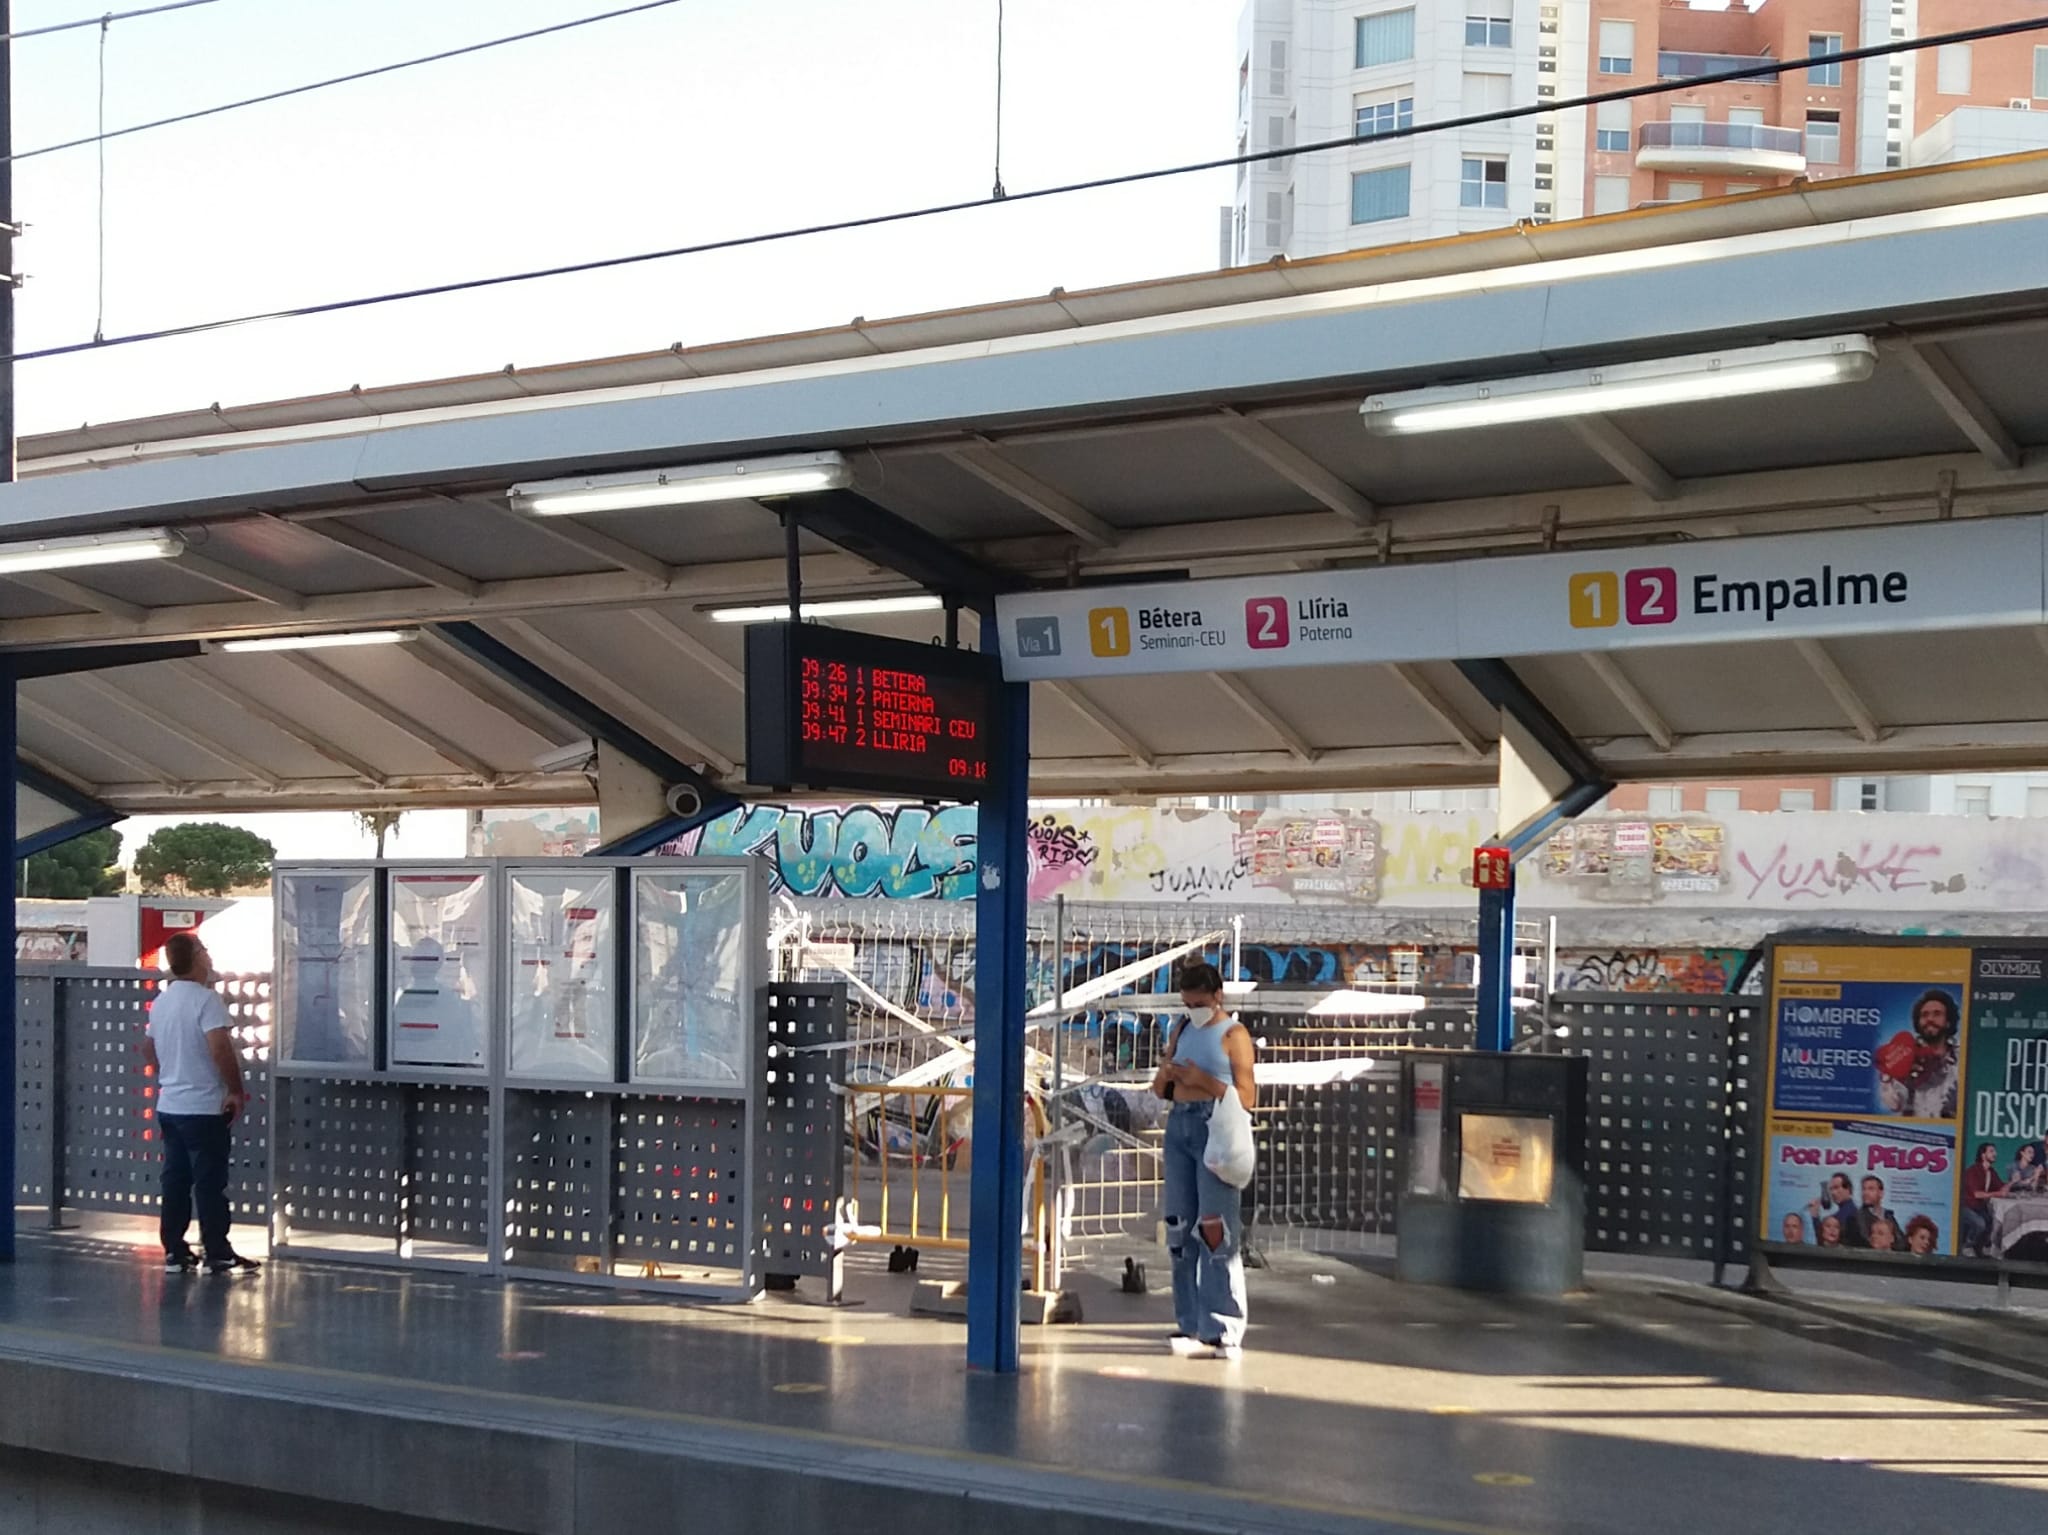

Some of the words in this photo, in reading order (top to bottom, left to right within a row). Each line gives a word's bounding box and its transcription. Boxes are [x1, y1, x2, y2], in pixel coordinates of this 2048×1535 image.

[1583, 581, 1601, 619] 1
[1639, 577, 1665, 616] 2
[1693, 565, 1908, 622] Empalme
[1138, 607, 1203, 630] Bétera
[1298, 597, 1349, 621] Llíria
[1100, 615, 1117, 650] 1
[1255, 604, 1279, 642] 2
[1299, 625, 1353, 642] Paterna
[1043, 626, 1056, 651] 1
[1138, 630, 1227, 650] Seminari-CEU
[857, 666, 864, 685] 1
[872, 669, 927, 693] BETERA
[855, 687, 866, 705] 2
[872, 689, 935, 714] PATERNA
[857, 708, 864, 726] 1
[872, 710, 942, 735] SEMINARI
[949, 719, 976, 740] CEU
[855, 728, 866, 747] 2
[872, 730, 927, 753] LLIRIA
[1979, 962, 2042, 975] OLYMPIA
[1784, 1006, 1881, 1026] HOMBRES
[1781, 1047, 1872, 1067] MUJERES
[1781, 1144, 1822, 1166] POR
[1825, 1148, 1858, 1166] LOS
[1866, 1143, 1949, 1174] PELOS
